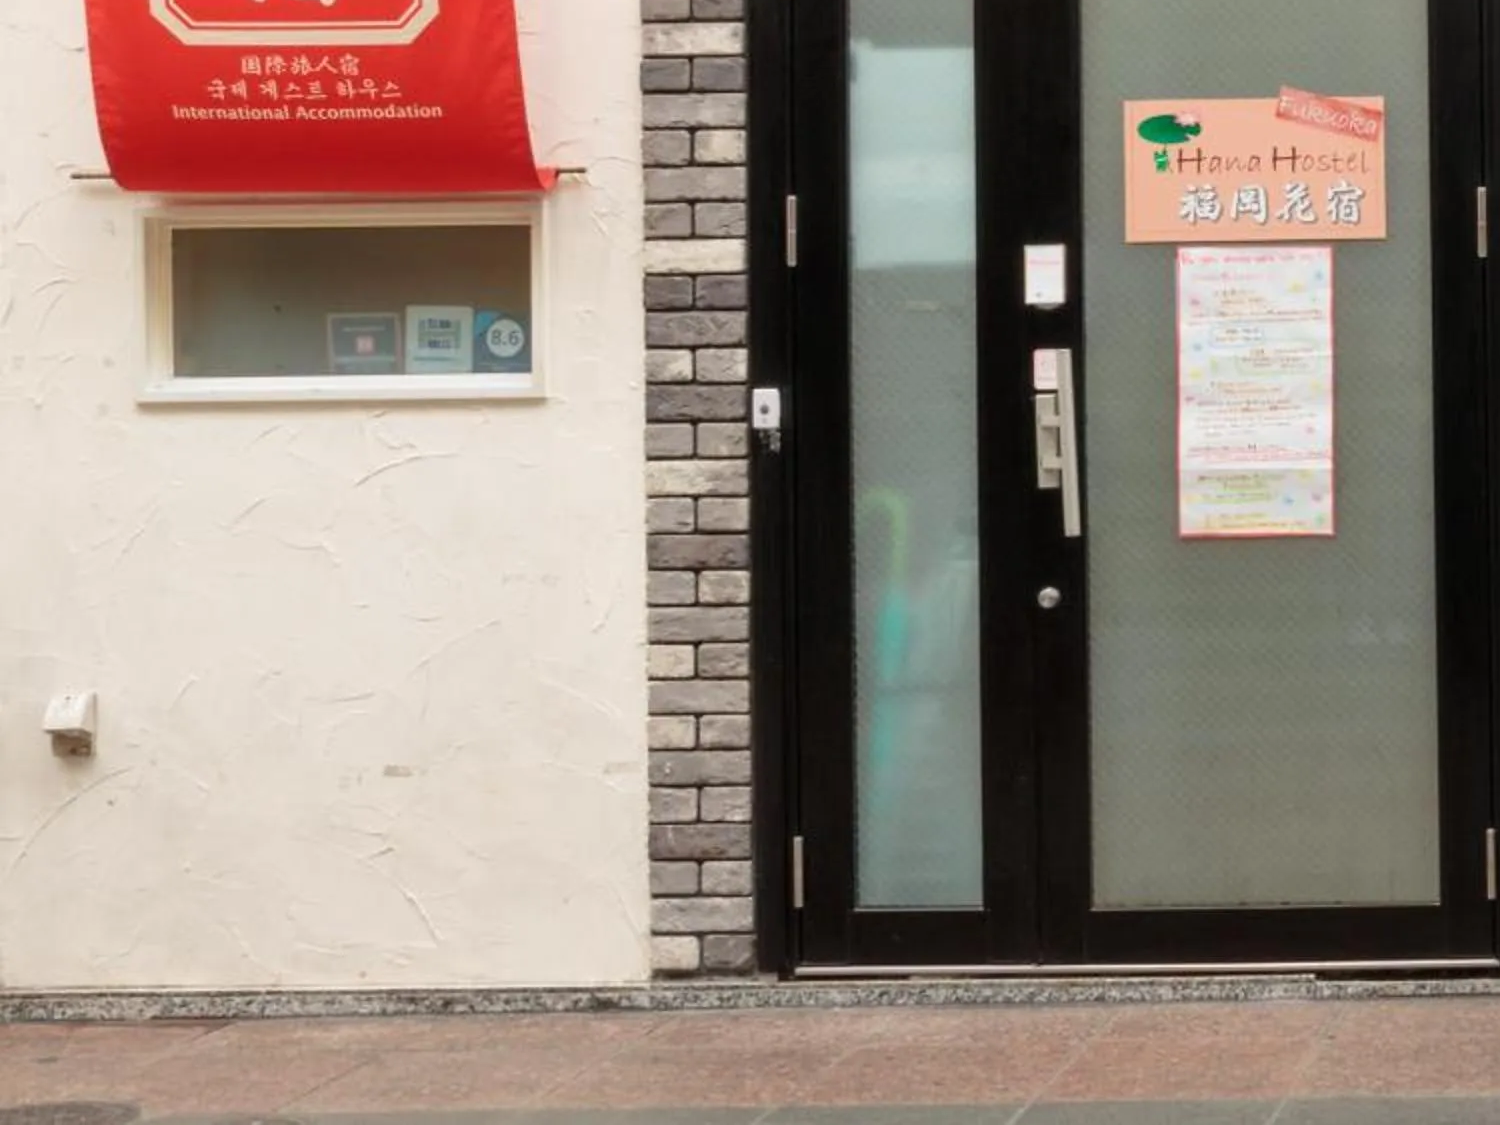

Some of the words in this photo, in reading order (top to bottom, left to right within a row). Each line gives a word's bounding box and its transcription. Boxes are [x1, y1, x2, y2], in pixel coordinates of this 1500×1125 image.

[172, 104, 289, 121] International
[296, 103, 443, 121] Accommodation
[1176, 146, 1261, 174] Hana
[1272, 146, 1370, 174] Hostel
[1179, 179, 1366, 225] 福岡花宿
